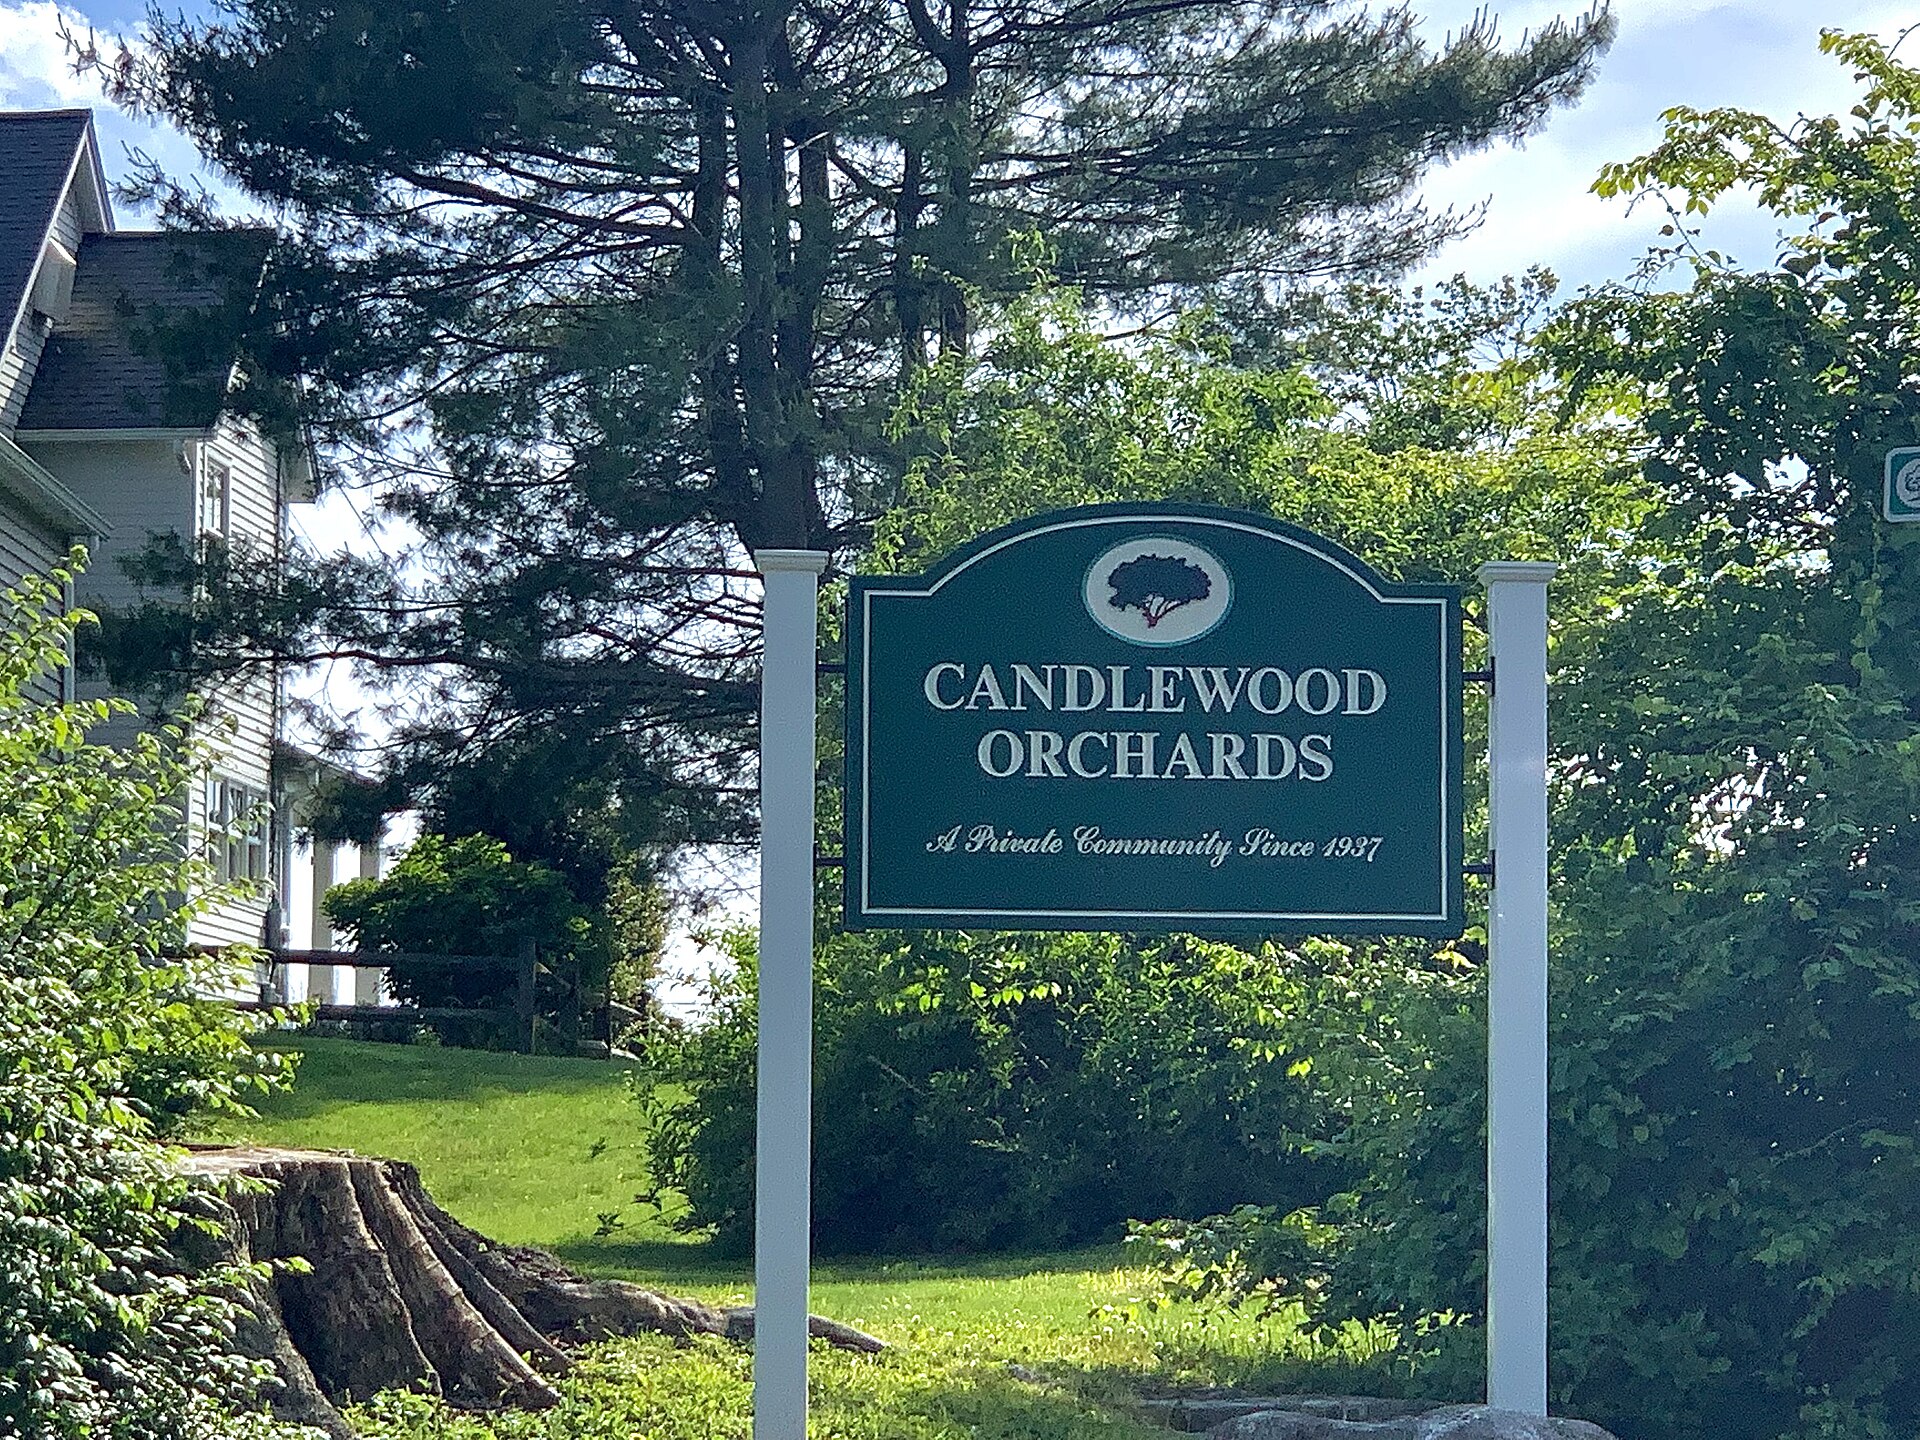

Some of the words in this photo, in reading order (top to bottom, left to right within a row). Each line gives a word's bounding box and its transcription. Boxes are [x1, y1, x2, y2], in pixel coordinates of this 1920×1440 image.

[923, 662, 1388, 715] CANDLEWOOD
[976, 729, 1335, 782] ORCHARDS
[925, 825, 959, 854] A
[964, 824, 1063, 854] Private
[1073, 825, 1233, 868] Community
[1239, 828, 1315, 857] Since
[1322, 836, 1384, 863] 1937
